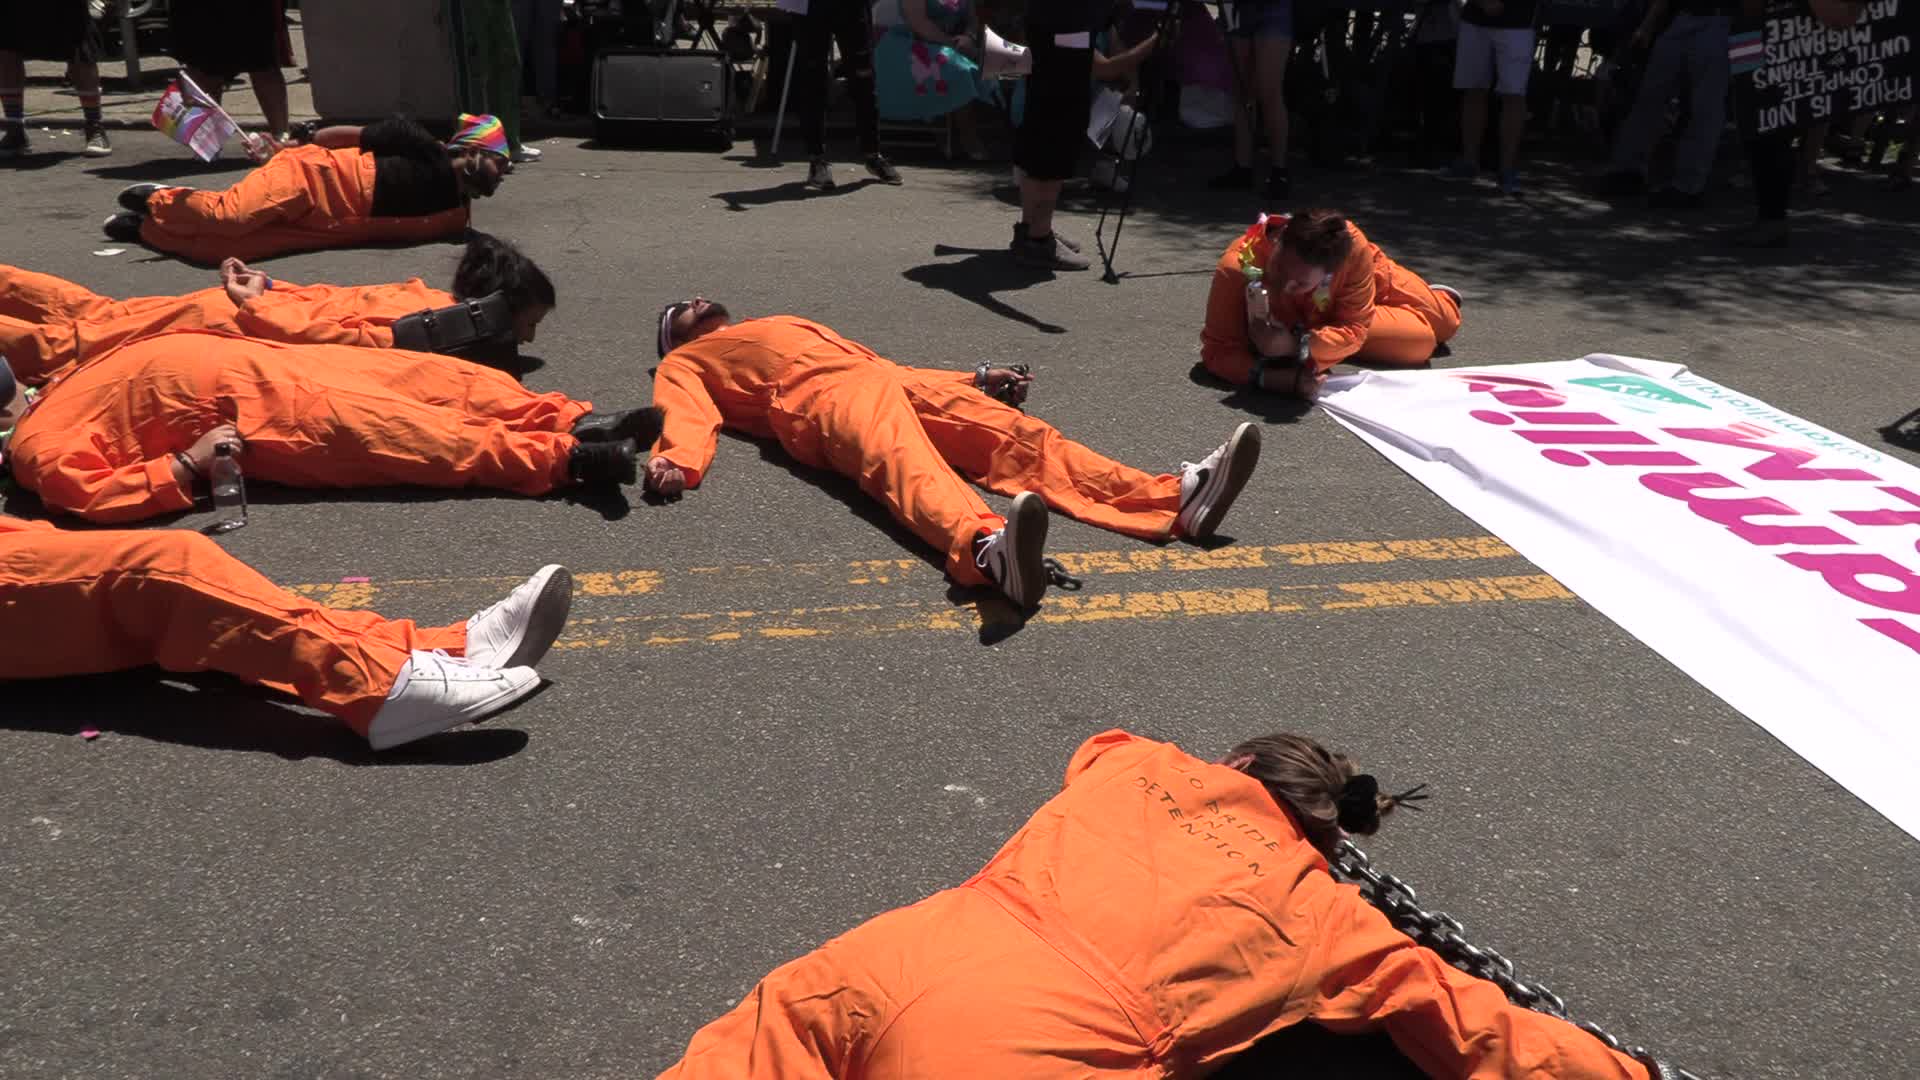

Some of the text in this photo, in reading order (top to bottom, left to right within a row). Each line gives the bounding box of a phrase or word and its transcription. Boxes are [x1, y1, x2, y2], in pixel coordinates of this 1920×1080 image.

[1753, 35, 1911, 89] UNTIL TRANS
[1765, 25, 1872, 65] MIGRANTS
[1757, 76, 1912, 133] PRIDE IS NOT
[1778, 62, 1884, 102] COMPLETE
[1131, 776, 1265, 877] DETENTION
[1194, 815, 1224, 829] IN
[1205, 800, 1280, 852] PRIDE
